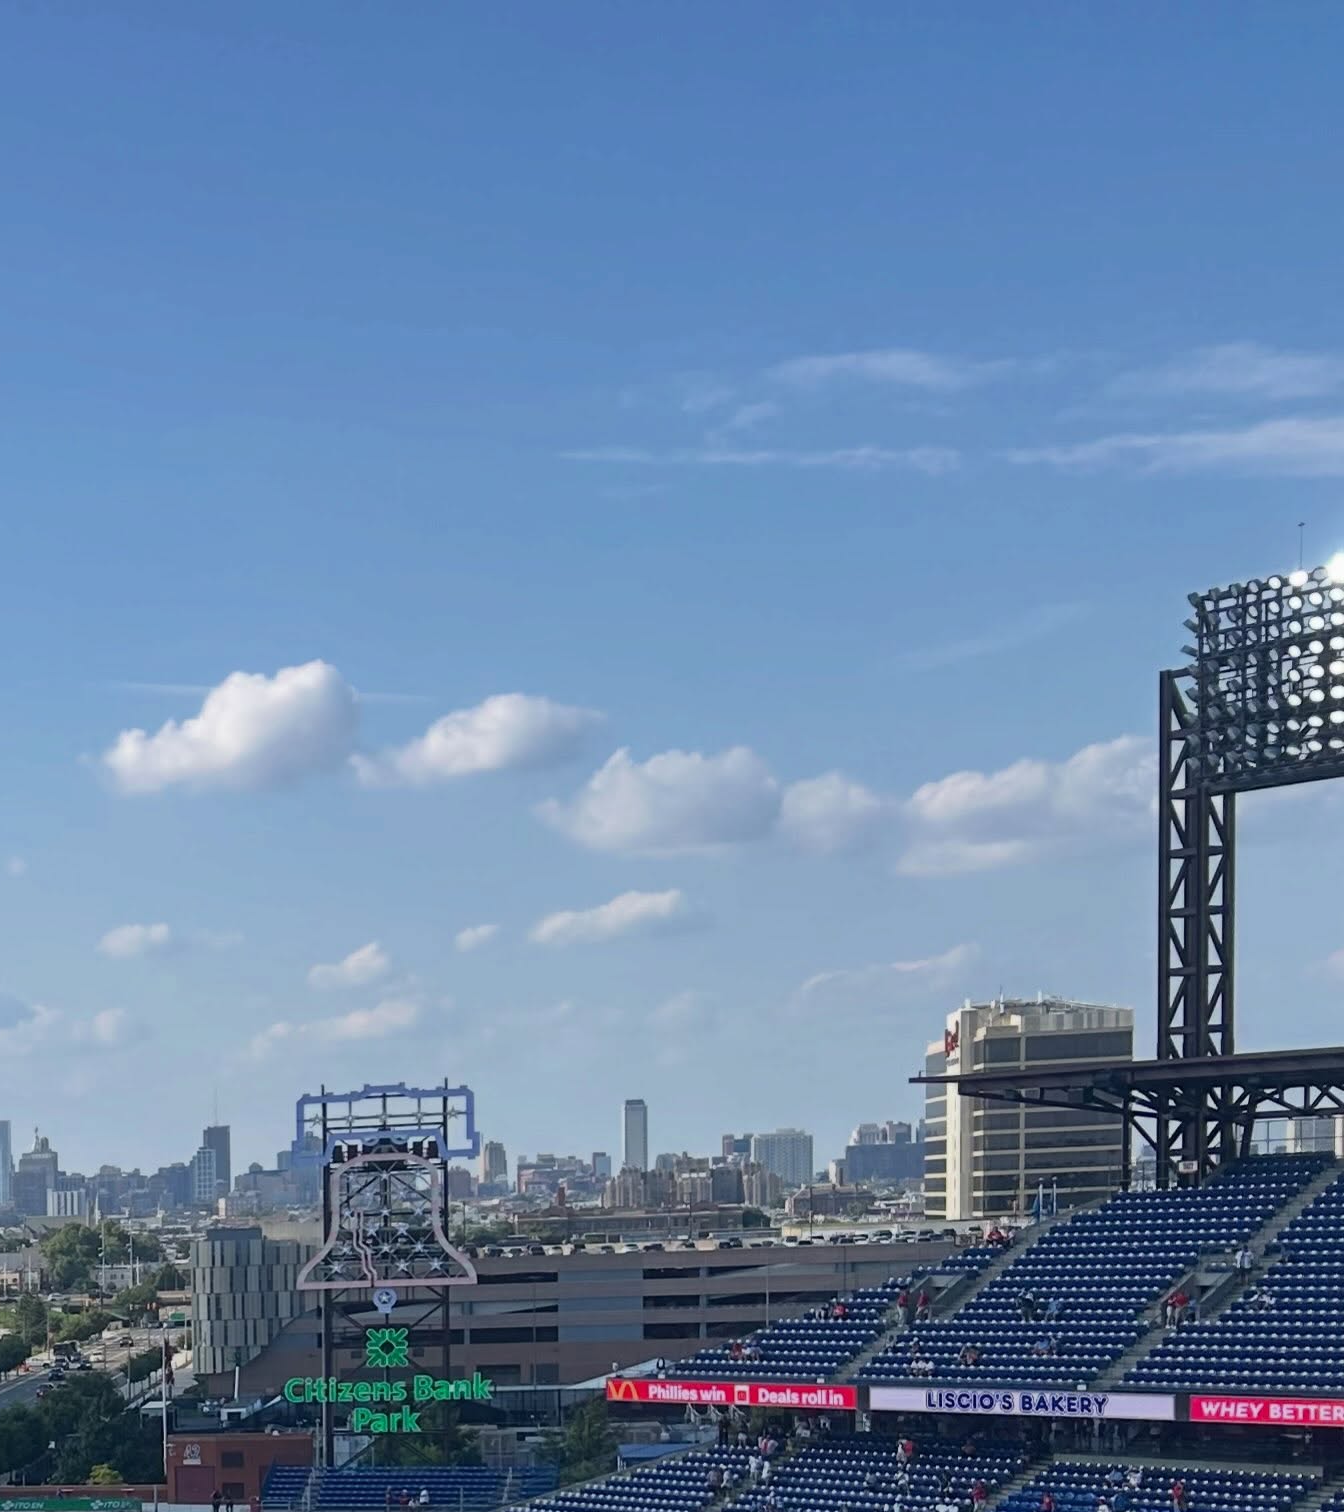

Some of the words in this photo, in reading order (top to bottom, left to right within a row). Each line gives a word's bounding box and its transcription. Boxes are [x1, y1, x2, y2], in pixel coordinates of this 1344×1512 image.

[284, 1376, 407, 1403] Citizens
[413, 1371, 494, 1401] Bank
[648, 1383, 698, 1400] Phillies
[700, 1386, 726, 1402] win
[758, 1388, 795, 1404] Deals
[797, 1389, 823, 1405] roll
[826, 1390, 844, 1406] in
[926, 1391, 1013, 1411] LISCIO'S
[1020, 1393, 1109, 1415] BAKERY
[1201, 1401, 1265, 1419] WHEY
[1269, 1403, 1344, 1422] BETTER
[353, 1405, 421, 1434] Park
